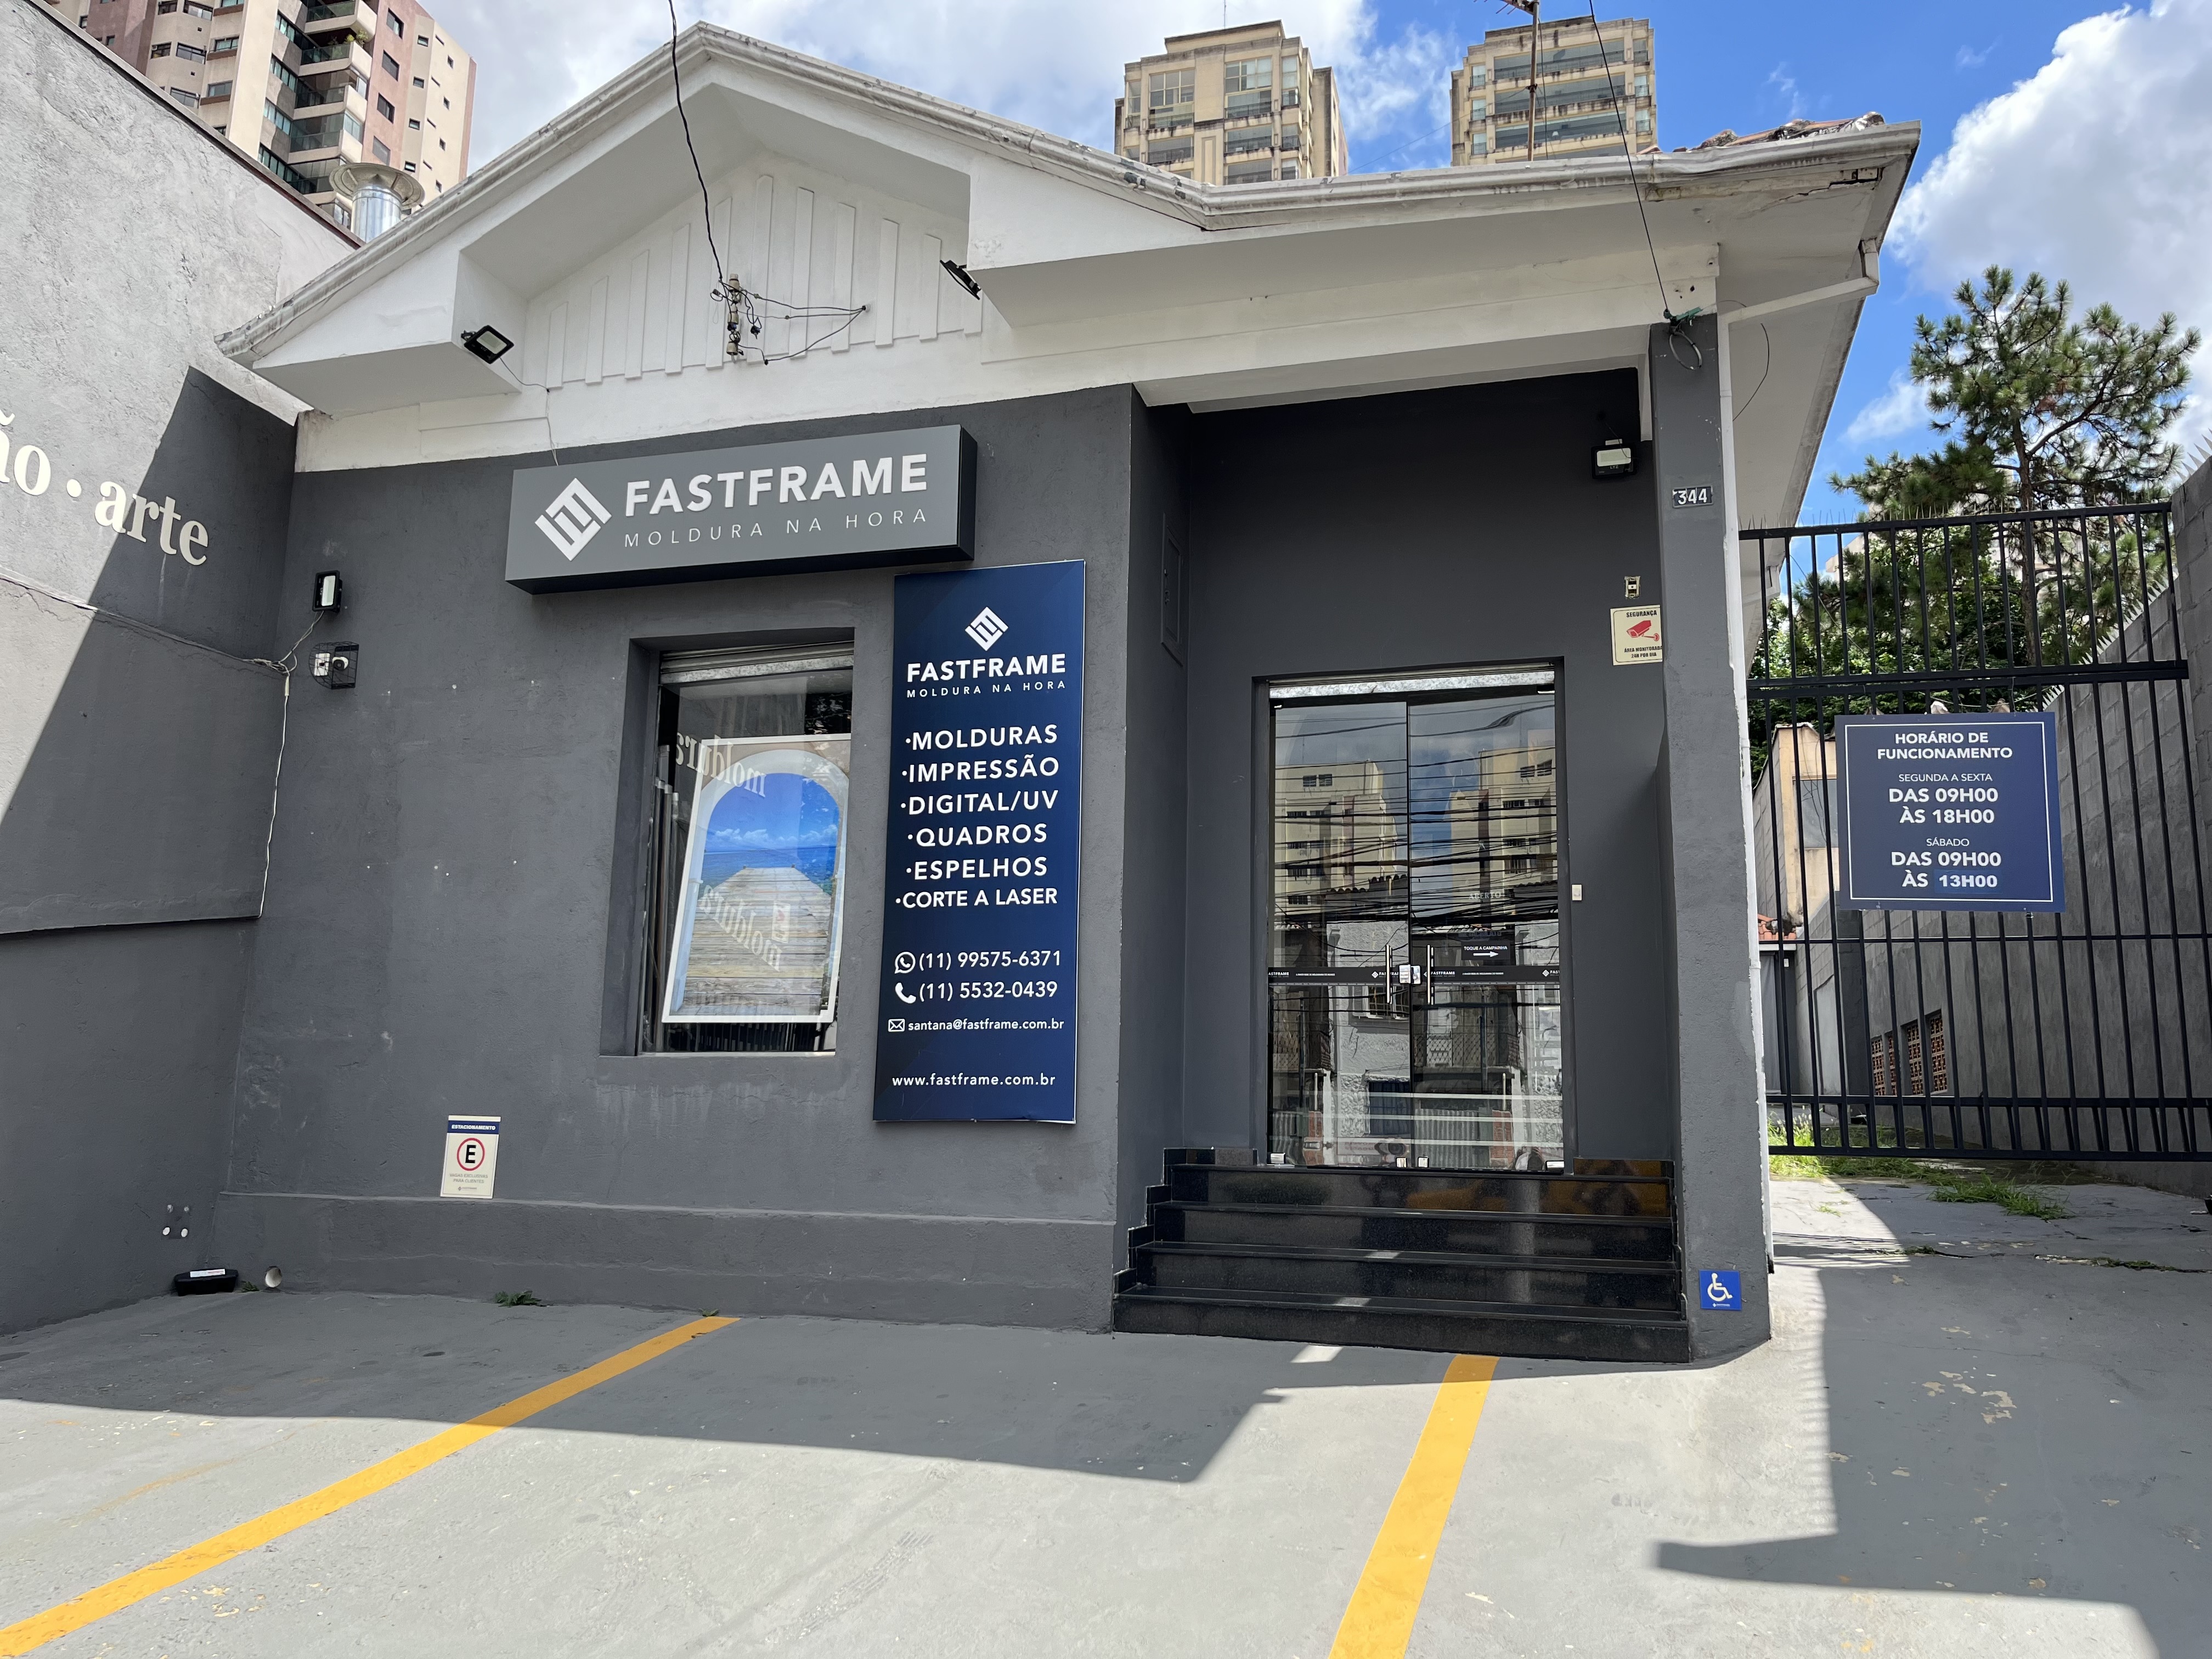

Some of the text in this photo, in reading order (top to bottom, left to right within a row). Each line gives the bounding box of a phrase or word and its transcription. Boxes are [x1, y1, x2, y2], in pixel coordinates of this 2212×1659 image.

[625, 454, 927, 517] FASTFRAME
[1678, 488, 1707, 504] 344
[94, 481, 209, 566] arte
[624, 508, 927, 548] MOLDURA NA HORA
[907, 653, 1065, 682] FASTFRAME
[907, 680, 1065, 698] MOLDURA NA HORA
[1895, 731, 1989, 744] HORÁRIO DE
[1877, 747, 2013, 759] FUNCIONAMENTO
[1899, 773, 1993, 782] SEGUNDA A SEXTA
[1889, 788, 1998, 803] DAS 09H00
[1899, 806, 1994, 823] ÀS 18H00
[1926, 837, 1970, 847] SÁBADO
[1891, 852, 2001, 867] DAS 09H00
[1901, 870, 1998, 888] ÀS 13H00
[974, 890, 989, 906] A
[996, 888, 1058, 905] LASER
[919, 950, 1061, 971] (11) 99575-6371
[919, 981, 1058, 1002] (11) 5532-0439
[908, 1018, 1064, 1031] santana@fastframe.com.br
[892, 1073, 1056, 1086] www.fastframe.com.br
[465, 1144, 477, 1164] E
